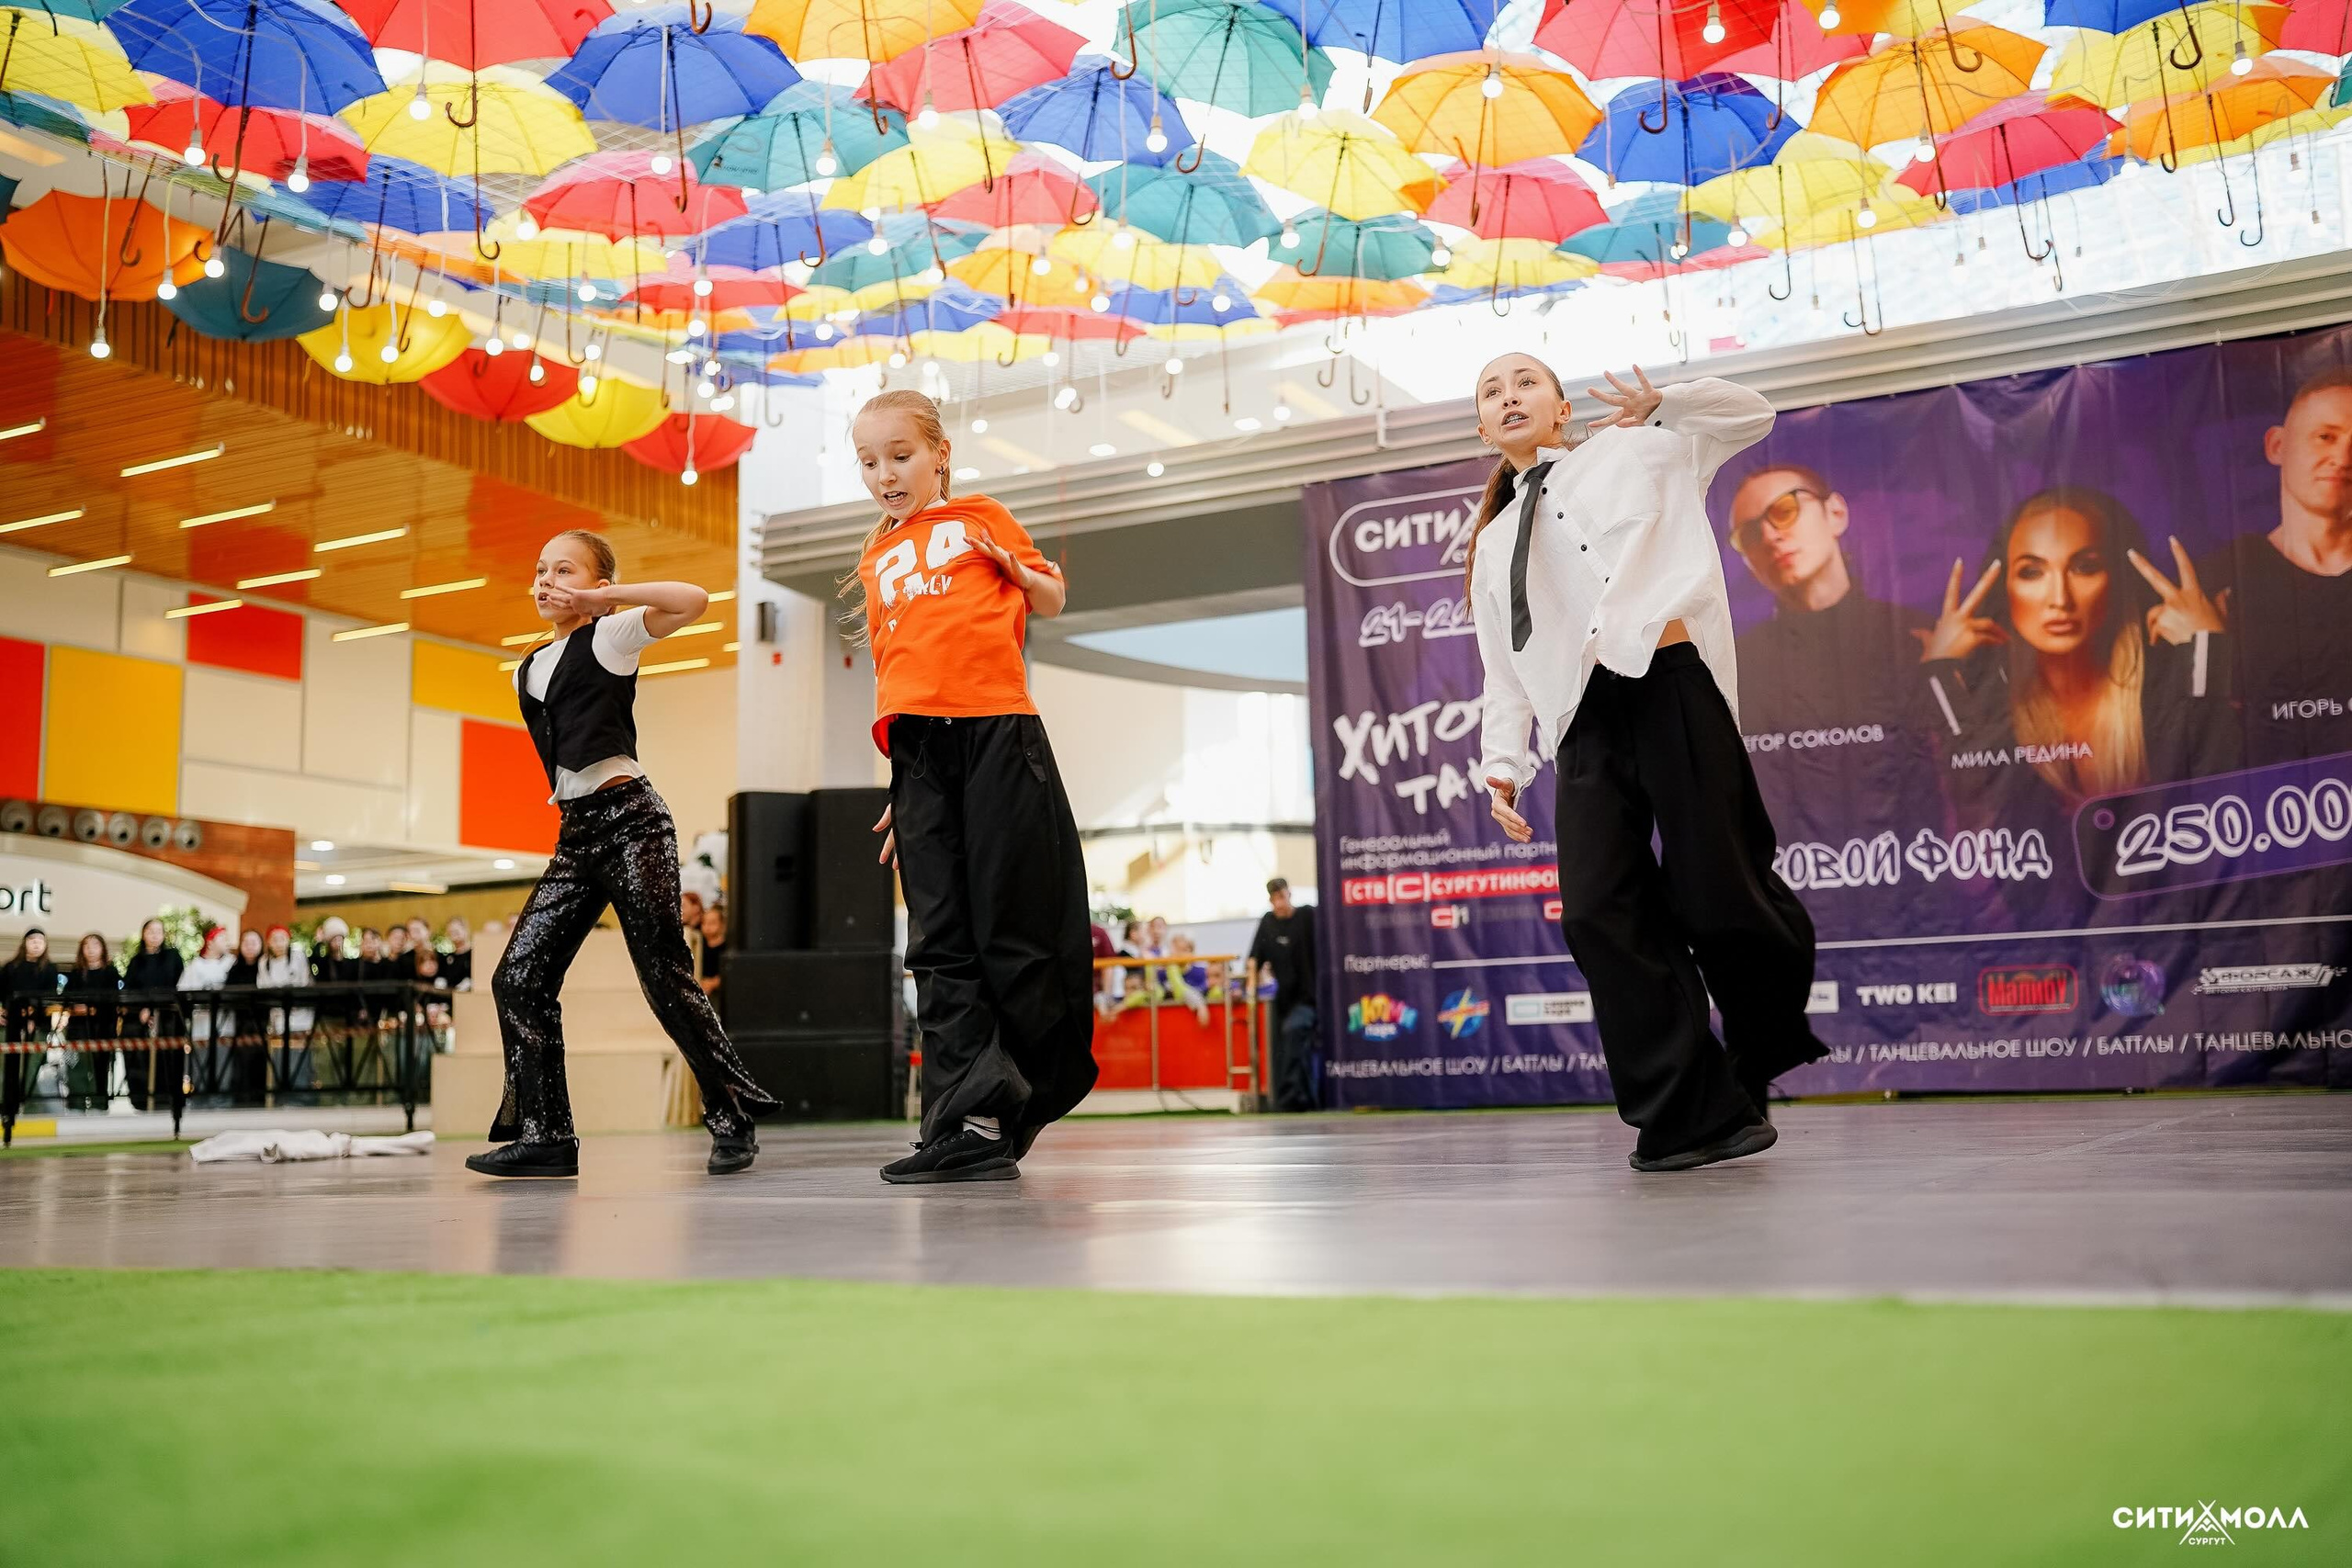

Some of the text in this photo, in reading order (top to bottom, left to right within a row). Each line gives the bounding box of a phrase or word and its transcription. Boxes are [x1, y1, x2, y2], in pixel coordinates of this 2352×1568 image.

[1354, 508, 1462, 553] СИТИ
[2272, 697, 2343, 720] ИГОРЬ
[1333, 694, 1485, 785] ХИТО
[1788, 724, 1884, 750] СОКОЛОВ
[1951, 740, 2094, 770] МИЛА РЕДИНА
[2115, 777, 2352, 876] 250.00
[1340, 828, 1452, 854] Генеральный
[1340, 840, 1557, 872] информационный партн
[1430, 869, 1559, 897] СУРГУТИНФО
[1856, 981, 1958, 1006] TWO KEI
[1869, 1038, 2021, 1062] ТАНЦЕВАЛЬНОЕ
[2025, 1037, 2078, 1058] ШОУ
[2097, 1033, 2174, 1055] БАТТЛЫ
[1326, 1056, 1443, 1078] ТАНЦЕВАЛЬНОЕ
[1445, 1055, 1489, 1076] ШОУ
[1578, 1053, 1608, 1071] ТАН
